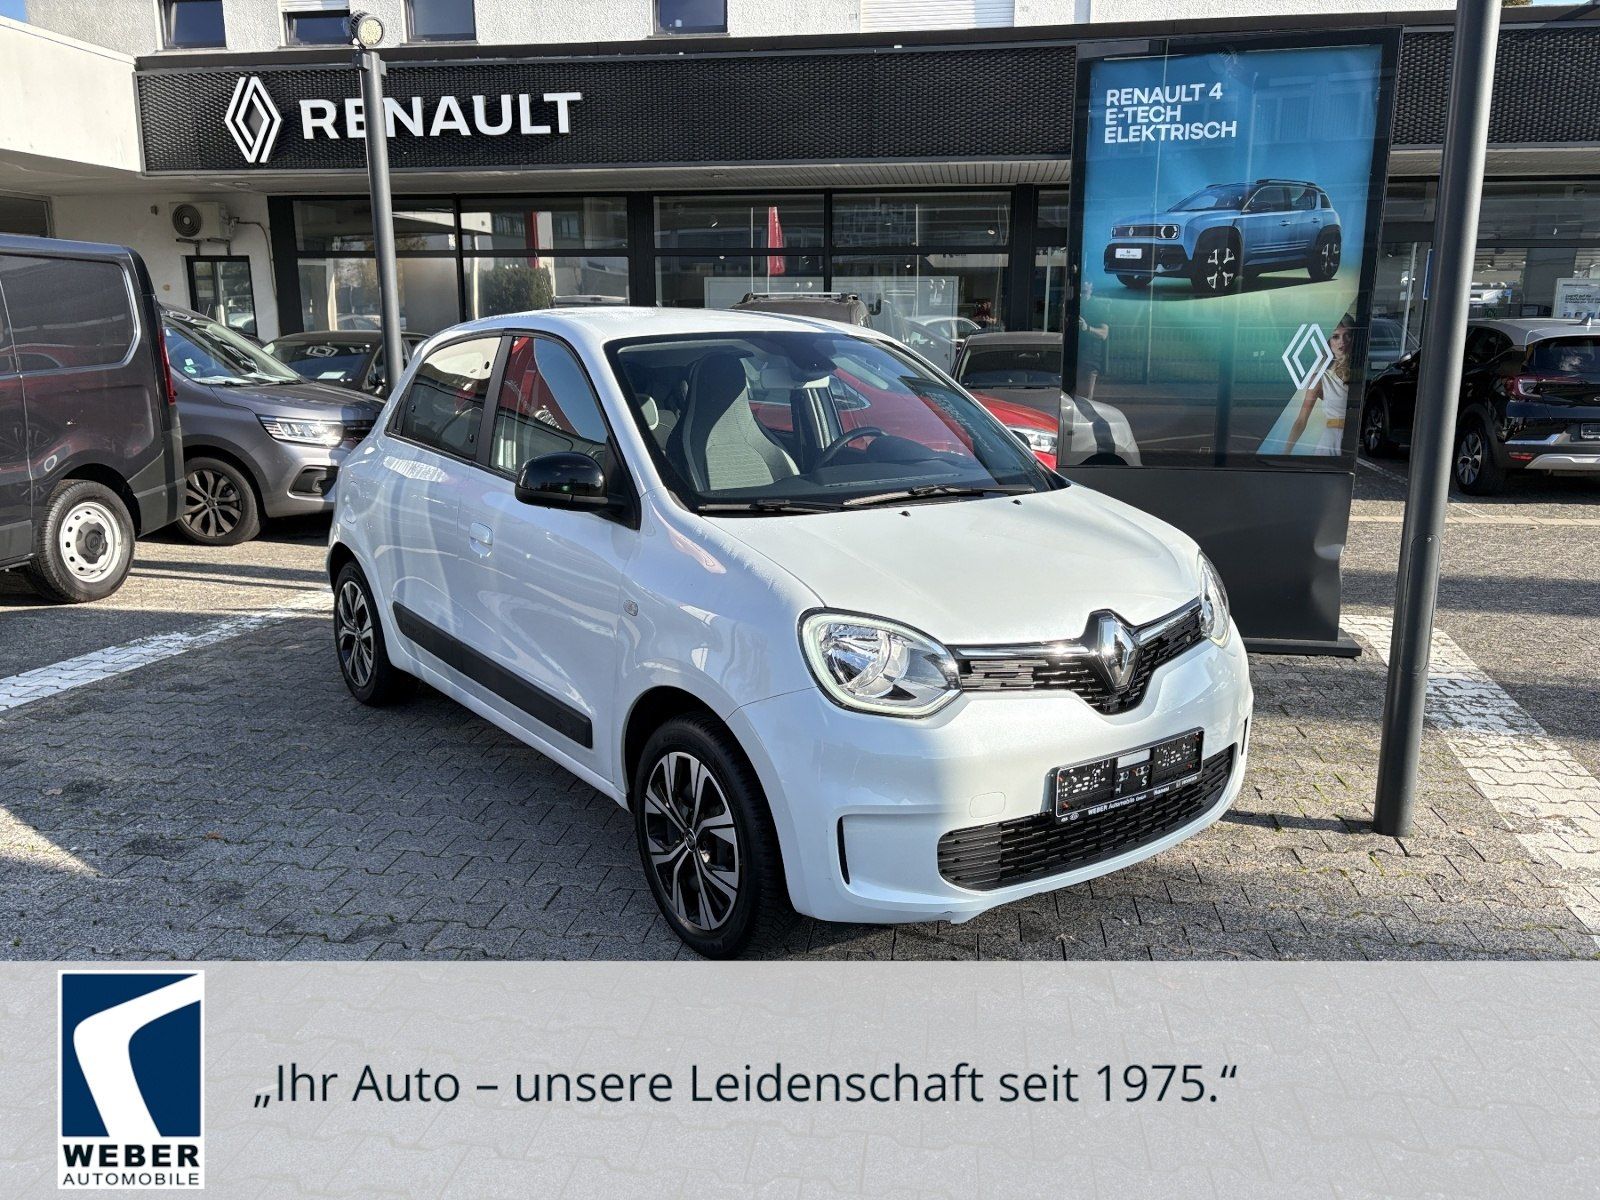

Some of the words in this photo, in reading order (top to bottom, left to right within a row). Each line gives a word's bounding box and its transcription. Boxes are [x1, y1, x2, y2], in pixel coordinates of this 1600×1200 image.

[1106, 83, 1206, 107] RENAULT
[1208, 82, 1223, 100] 4
[299, 92, 583, 140] RENAULT
[1105, 104, 1182, 125] E-TECH
[1104, 120, 1238, 144] ELEKTRISCH
[1088, 804, 1108, 816] WEBER
